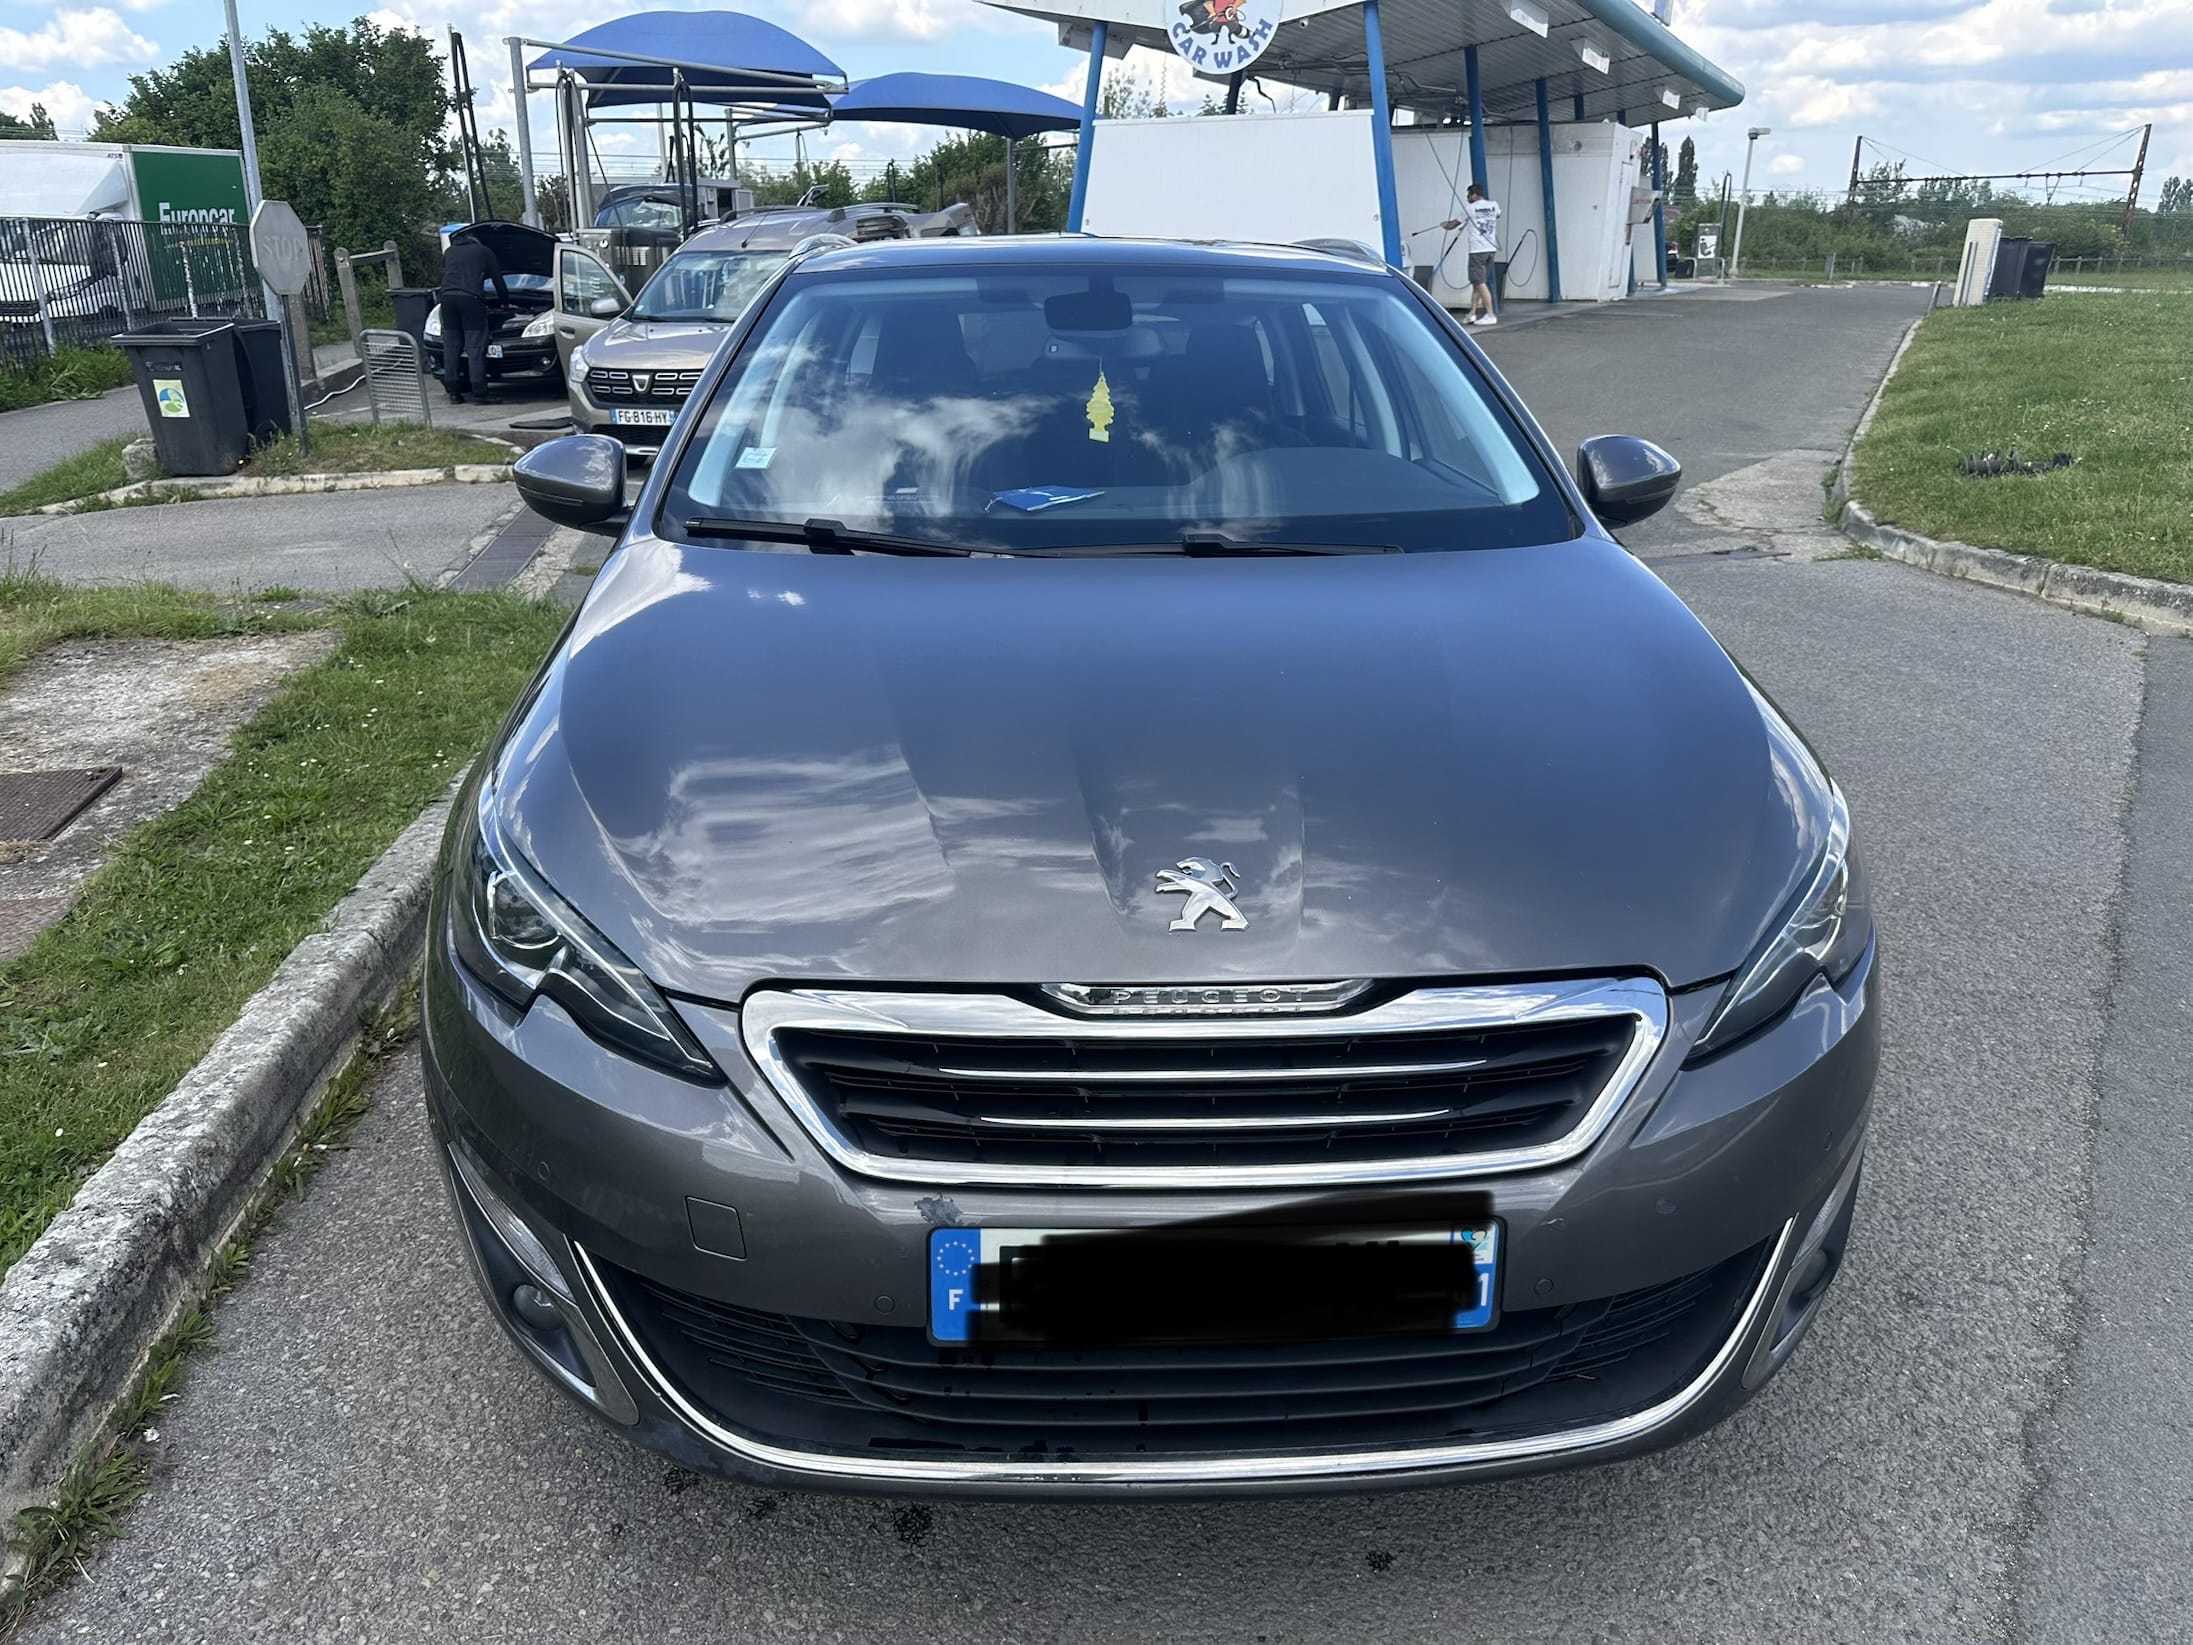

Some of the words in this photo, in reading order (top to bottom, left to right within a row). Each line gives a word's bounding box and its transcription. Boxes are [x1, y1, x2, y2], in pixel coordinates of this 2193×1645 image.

[1172, 22, 1207, 65] CAR
[1213, 18, 1273, 69] WASH
[262, 234, 303, 262] STOP
[1112, 987, 1309, 1004] PEUGEOT
[948, 1289, 964, 1310] F
[1478, 1272, 1489, 1306] 1
